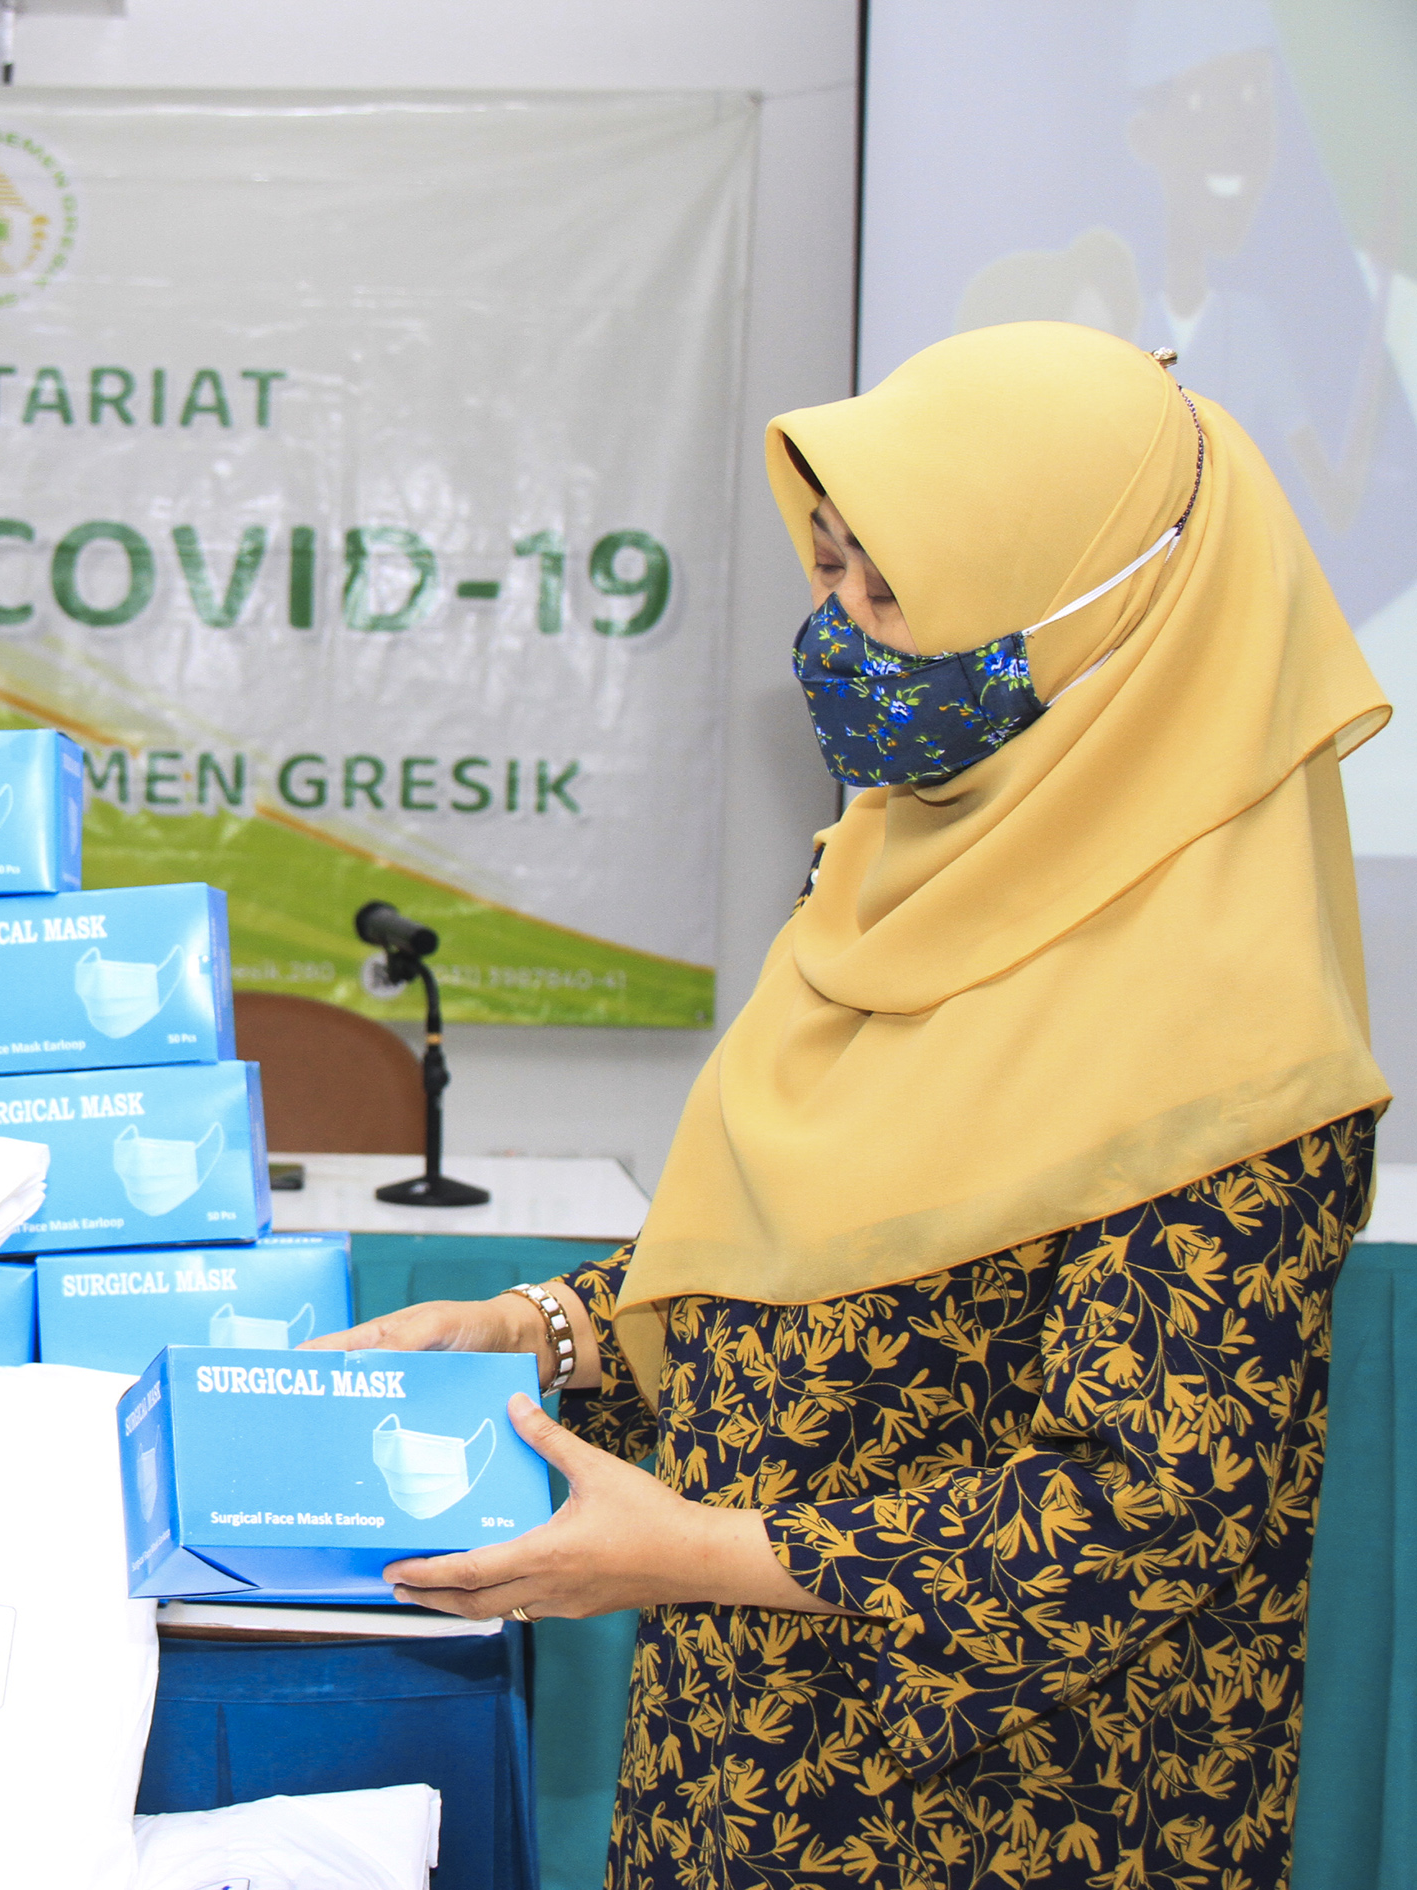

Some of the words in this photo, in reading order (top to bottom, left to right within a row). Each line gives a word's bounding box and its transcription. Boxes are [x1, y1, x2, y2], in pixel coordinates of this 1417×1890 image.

[82, 748, 246, 808] MEN
[277, 753, 581, 813] GRESIK
[5, 864, 21, 875] Pcs
[43, 915, 107, 942] MASK
[11, 1041, 41, 1053] Mask
[44, 1039, 86, 1052] Earloop
[167, 1034, 180, 1044] 50
[181, 1033, 197, 1043] Pcs
[80, 1092, 145, 1118] MASK
[207, 1211, 220, 1222] 50
[220, 1211, 236, 1221] Pcs
[23, 1222, 47, 1233] Face
[49, 1219, 80, 1231] Mask
[82, 1217, 124, 1229] Earloop
[63, 1271, 169, 1298] SURGICAL
[175, 1268, 237, 1292] MASK
[197, 1365, 325, 1396] SURGICAL
[332, 1370, 405, 1398] MASK
[211, 1511, 263, 1527] Surgical
[265, 1512, 296, 1525] Face
[298, 1512, 333, 1525] Mask
[336, 1513, 384, 1528] Earloop
[481, 1517, 496, 1528] 50
[497, 1517, 514, 1528] Pcs
